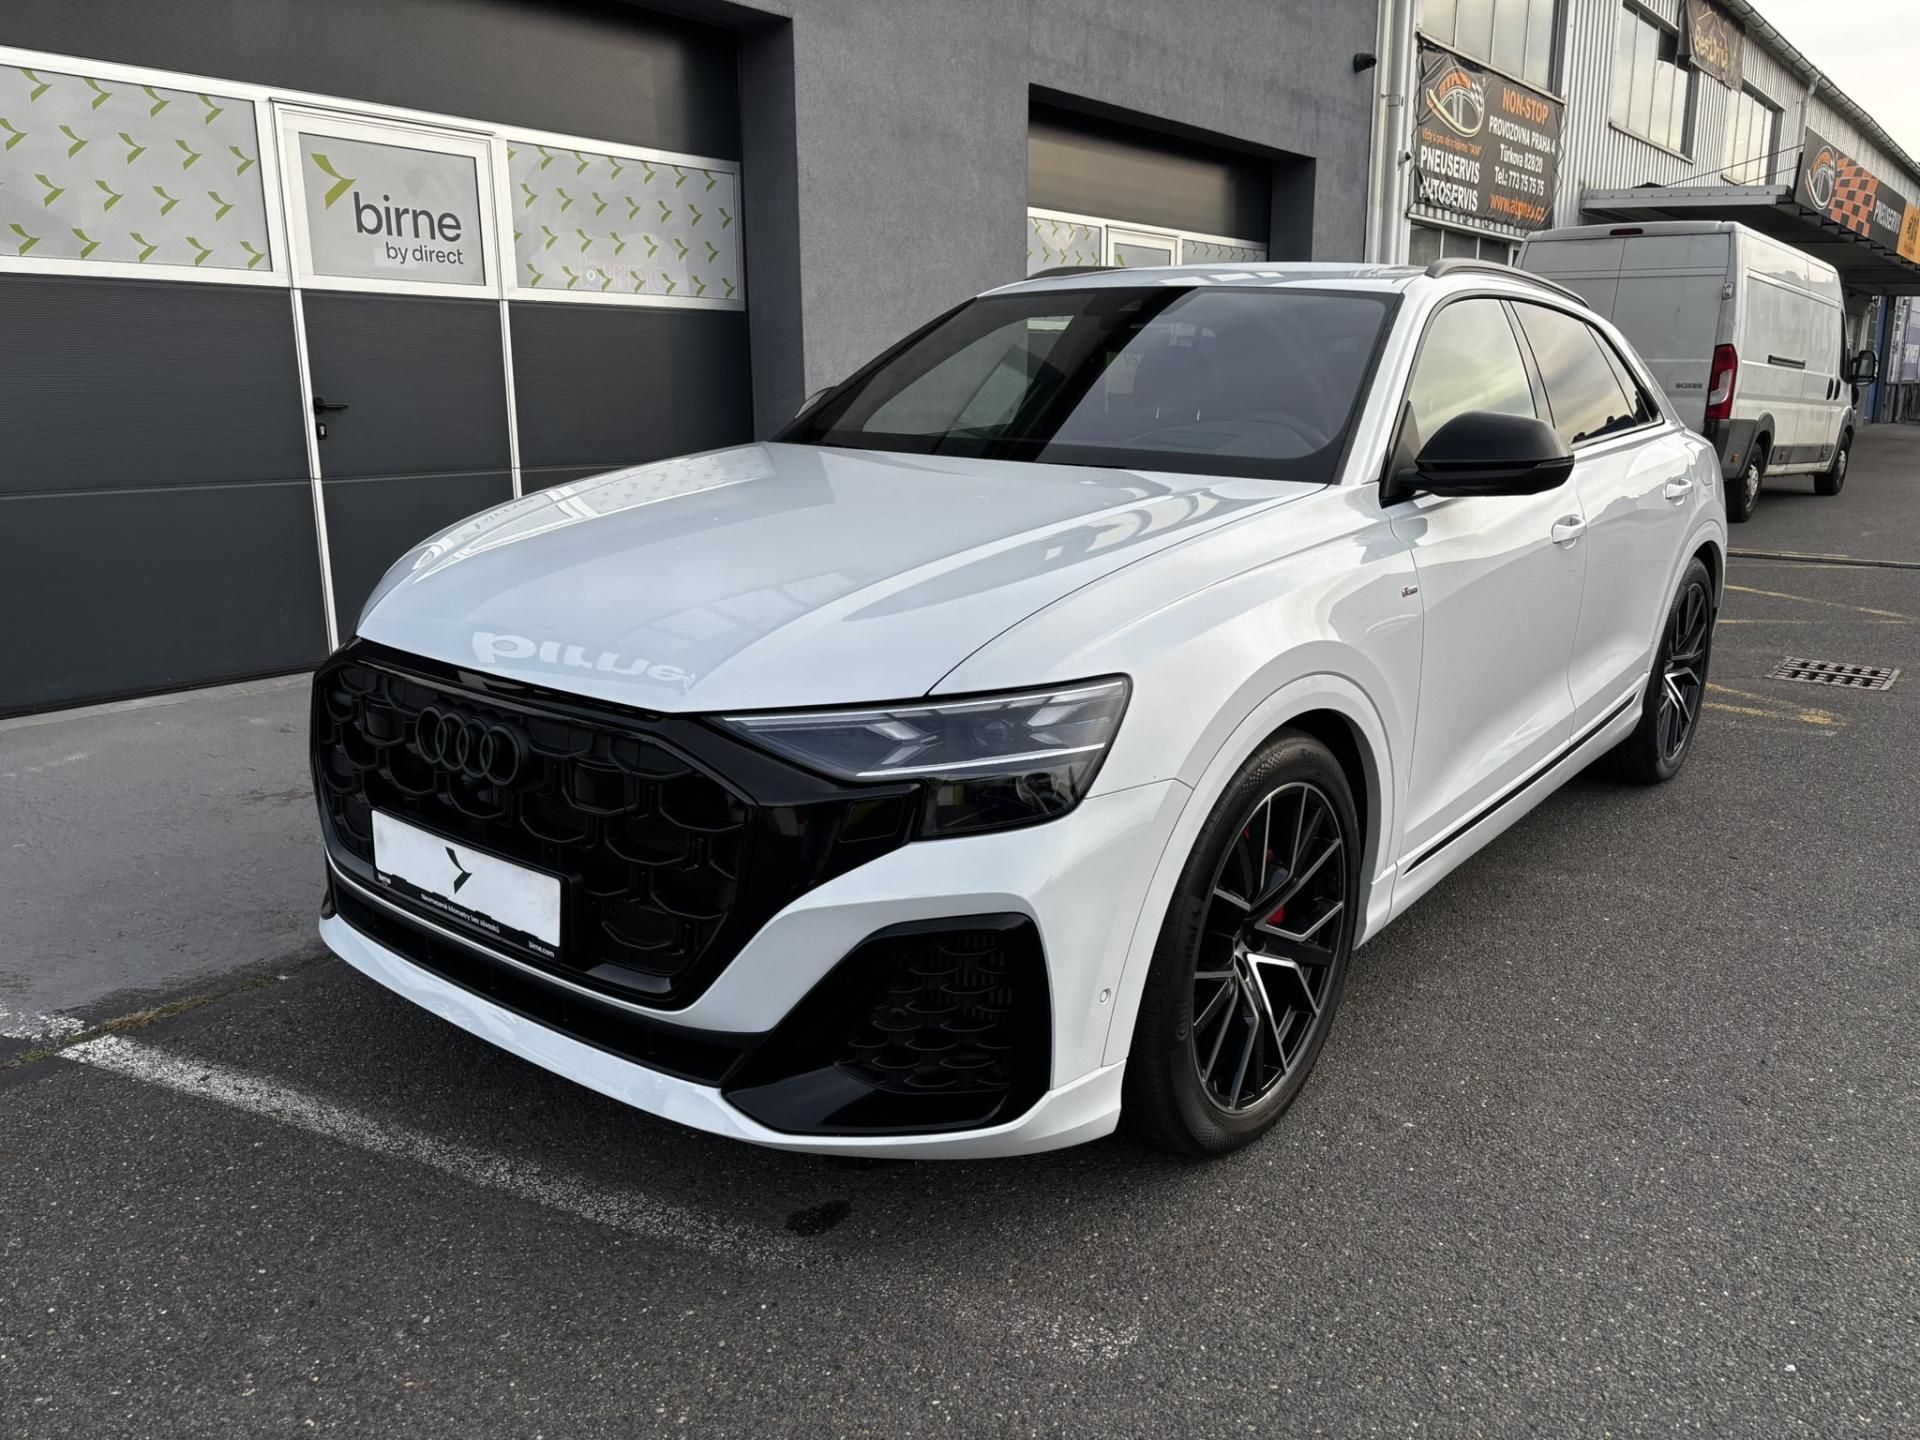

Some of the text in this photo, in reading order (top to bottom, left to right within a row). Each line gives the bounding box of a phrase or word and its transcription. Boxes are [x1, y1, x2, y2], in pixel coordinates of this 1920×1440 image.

[1503, 87, 1548, 125] NON-STOP
[1489, 115, 1530, 147] PROVOZOVNA
[1531, 131, 1550, 154] PRAHA
[1551, 139, 1556, 155] 4
[1420, 145, 1480, 184] PNEUSERVIS
[1509, 170, 1520, 190] 773
[1521, 174, 1529, 192] 75
[1529, 176, 1537, 194] 75
[1537, 179, 1544, 197] 75
[1419, 176, 1479, 212] AUTOSERVIS
[353, 191, 462, 242] birne
[386, 242, 464, 264] by direct
